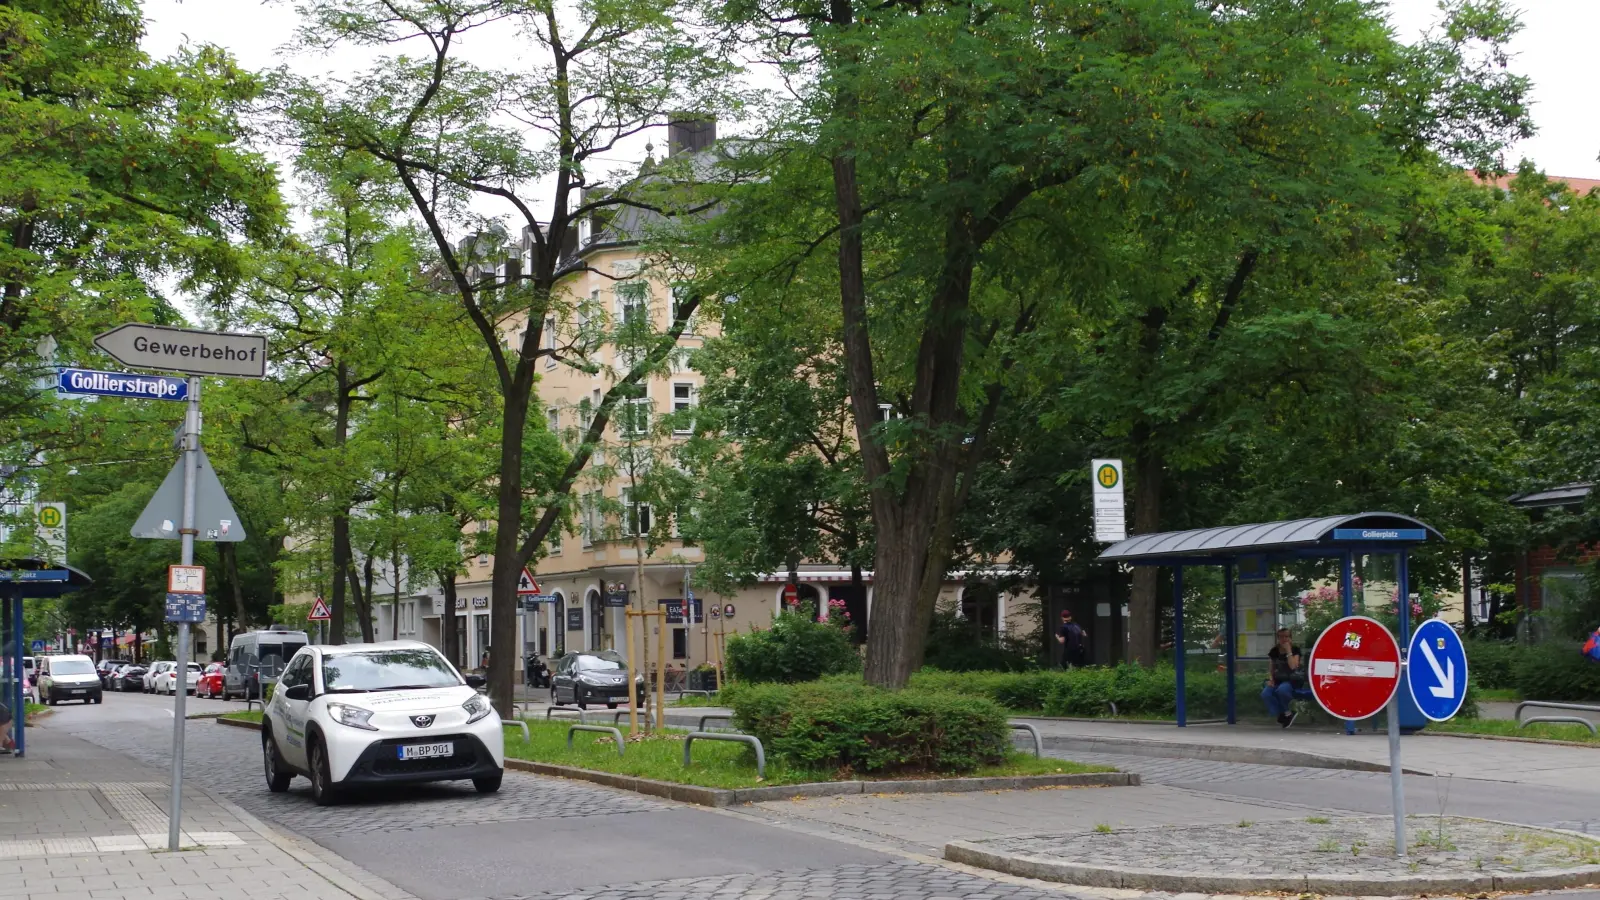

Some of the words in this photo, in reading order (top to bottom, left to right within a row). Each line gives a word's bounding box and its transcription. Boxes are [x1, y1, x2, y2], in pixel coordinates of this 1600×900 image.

[133, 336, 256, 361] Gewerbehof
[71, 371, 178, 398] Gollierstraße
[1103, 468, 1113, 484] H
[44, 511, 56, 524] H
[1362, 530, 1398, 539] Gollierplatz
[406, 747, 413, 757] M
[418, 746, 431, 756] BP
[432, 744, 449, 755] 901
